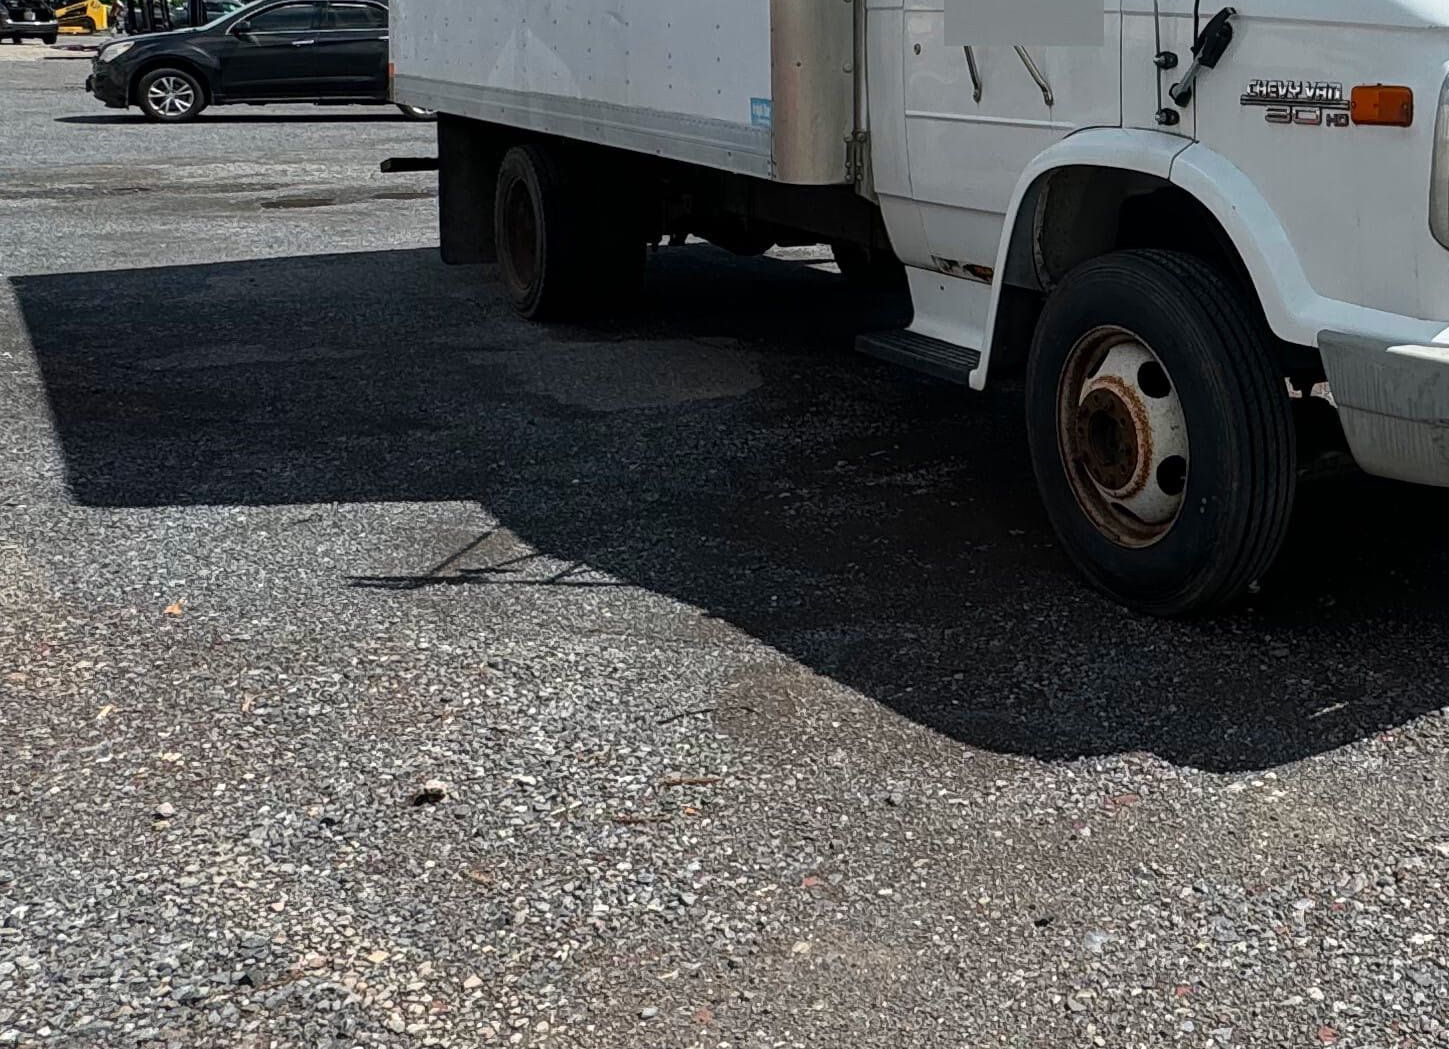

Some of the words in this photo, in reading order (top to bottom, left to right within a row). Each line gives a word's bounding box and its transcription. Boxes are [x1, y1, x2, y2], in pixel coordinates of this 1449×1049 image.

[1247, 79, 1301, 99] CHEVY
[1304, 81, 1343, 100] VAN
[1264, 106, 1322, 125] 30
[1325, 113, 1349, 127] HD
